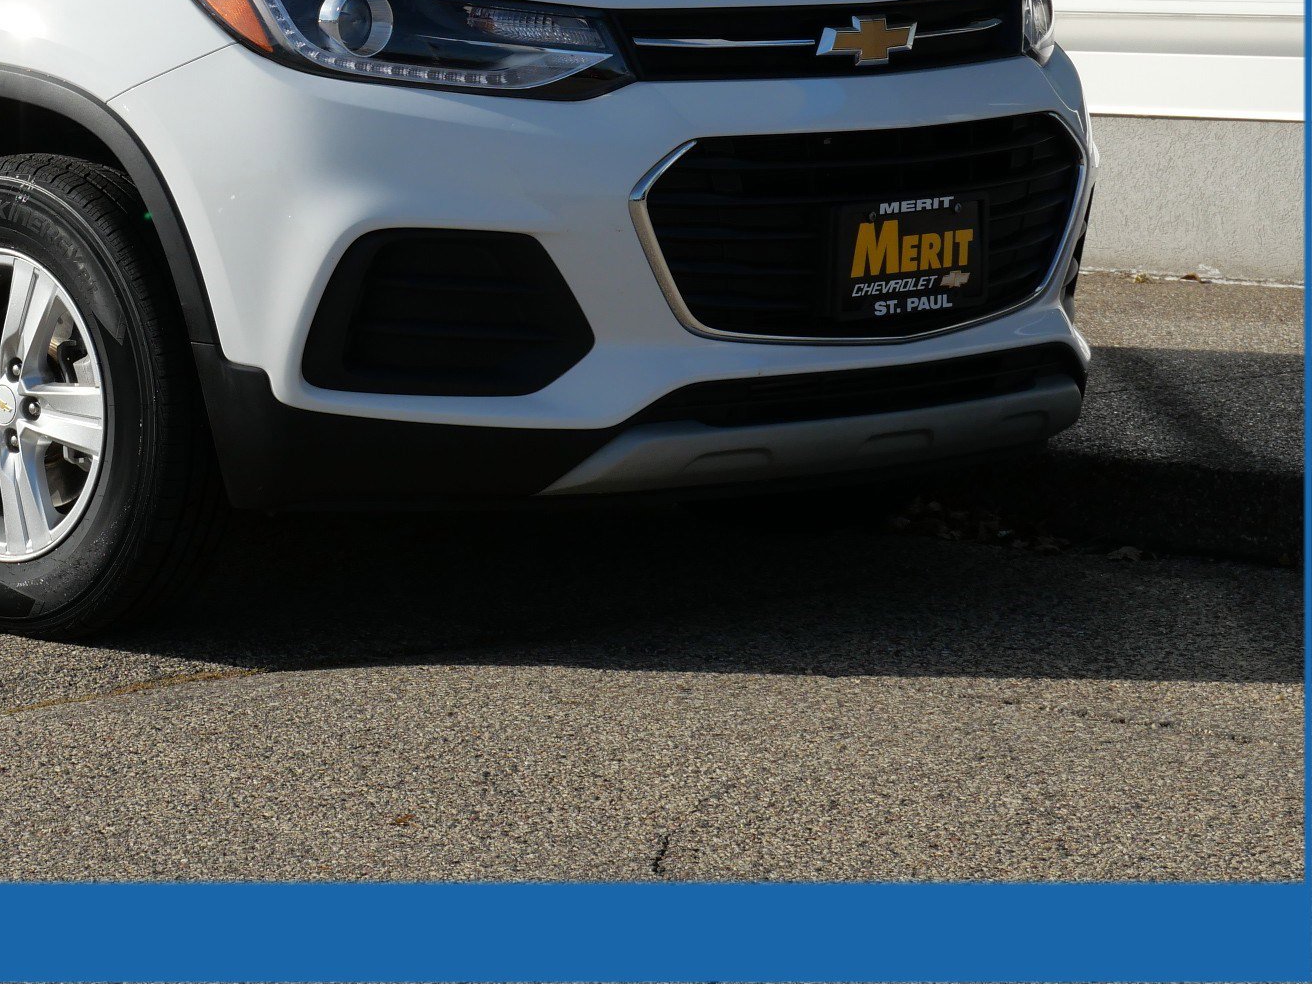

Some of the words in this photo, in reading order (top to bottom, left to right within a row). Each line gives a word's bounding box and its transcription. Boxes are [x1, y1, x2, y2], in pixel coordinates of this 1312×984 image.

[879, 196, 954, 215] MERIT
[850, 219, 974, 278] MERIT
[852, 275, 938, 297] CHEVROLET
[874, 300, 901, 316] ST.
[907, 294, 953, 312] PAUL
